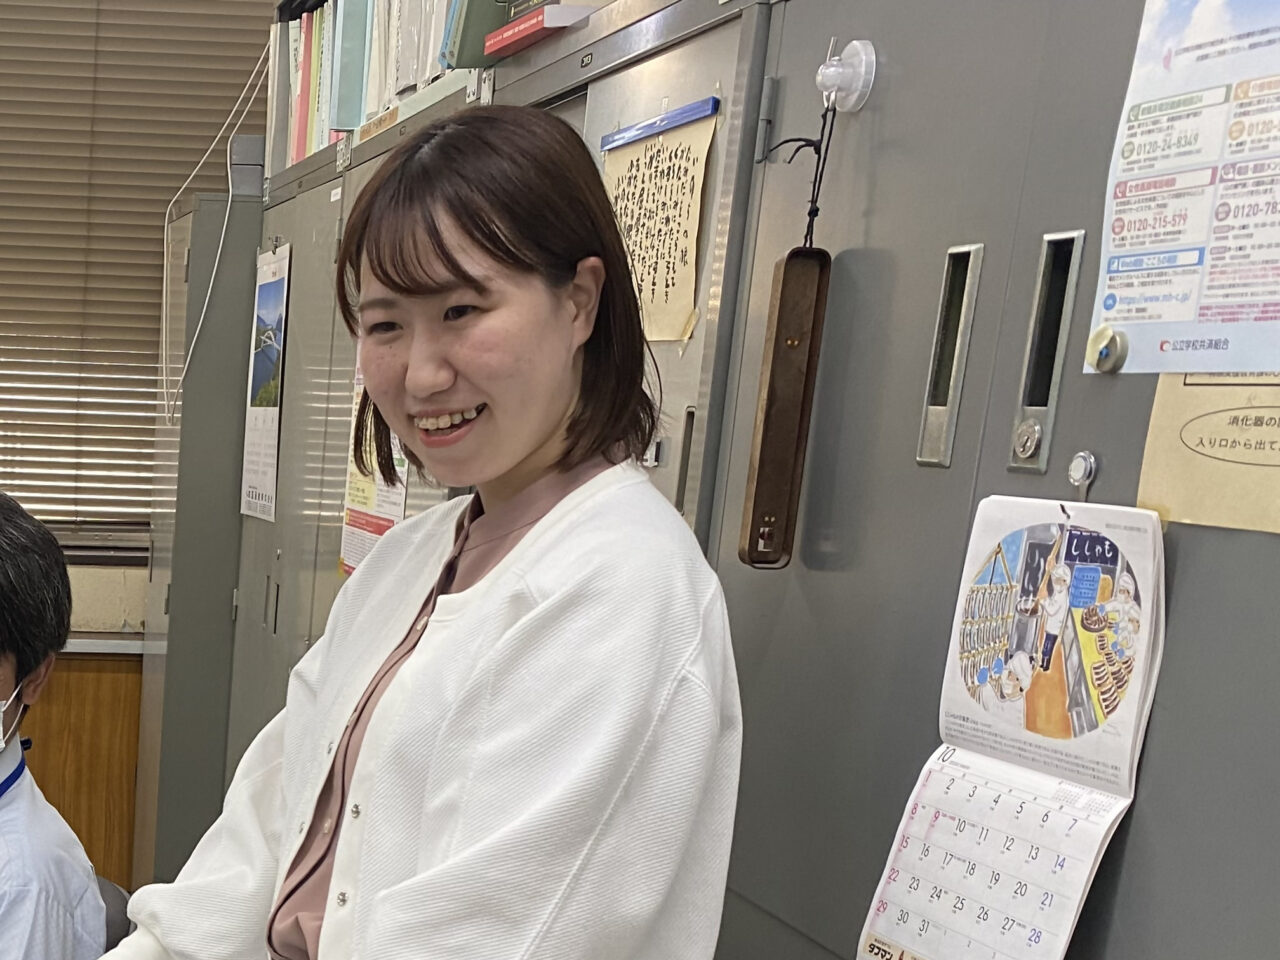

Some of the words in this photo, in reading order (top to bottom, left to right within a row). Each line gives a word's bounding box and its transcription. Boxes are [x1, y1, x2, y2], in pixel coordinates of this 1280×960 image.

[1136, 133, 1200, 157] 0120-24-8349
[1126, 213, 1189, 233] 0120-215-579
[1171, 338, 1230, 351] 公立学校共済組合
[1227, 415, 1280, 428] 消化器の
[1195, 436, 1280, 451] 入り口から出て
[937, 745, 957, 763] 10
[924, 770, 932, 783] 1
[946, 778, 955, 791] 2
[968, 785, 978, 798] 3
[992, 793, 1002, 806] 4
[1016, 801, 1026, 815] 5
[1041, 810, 1050, 824] 6
[1067, 818, 1078, 832] 7
[911, 802, 919, 816] 8
[933, 810, 941, 823] 9
[955, 818, 967, 833] 10
[978, 826, 990, 841] 11
[1003, 836, 1015, 851] 12
[1028, 845, 1040, 861] 13
[1055, 854, 1067, 870] 14
[900, 835, 909, 848] 15
[921, 843, 930, 858] 16
[943, 851, 954, 866] 17
[965, 861, 977, 876] 18
[990, 870, 1001, 886] 19
[1014, 881, 1028, 897] 20
[1040, 891, 1054, 908] 21
[876, 899, 888, 913] 29
[897, 909, 909, 924] 30
[919, 919, 930, 934] 31
[888, 867, 900, 883] 22
[908, 876, 920, 891] 23
[929, 886, 943, 901] 24
[953, 896, 966, 911] 25
[977, 906, 990, 922] 26
[1001, 917, 1016, 932] 27
[1028, 928, 1042, 945] 28
